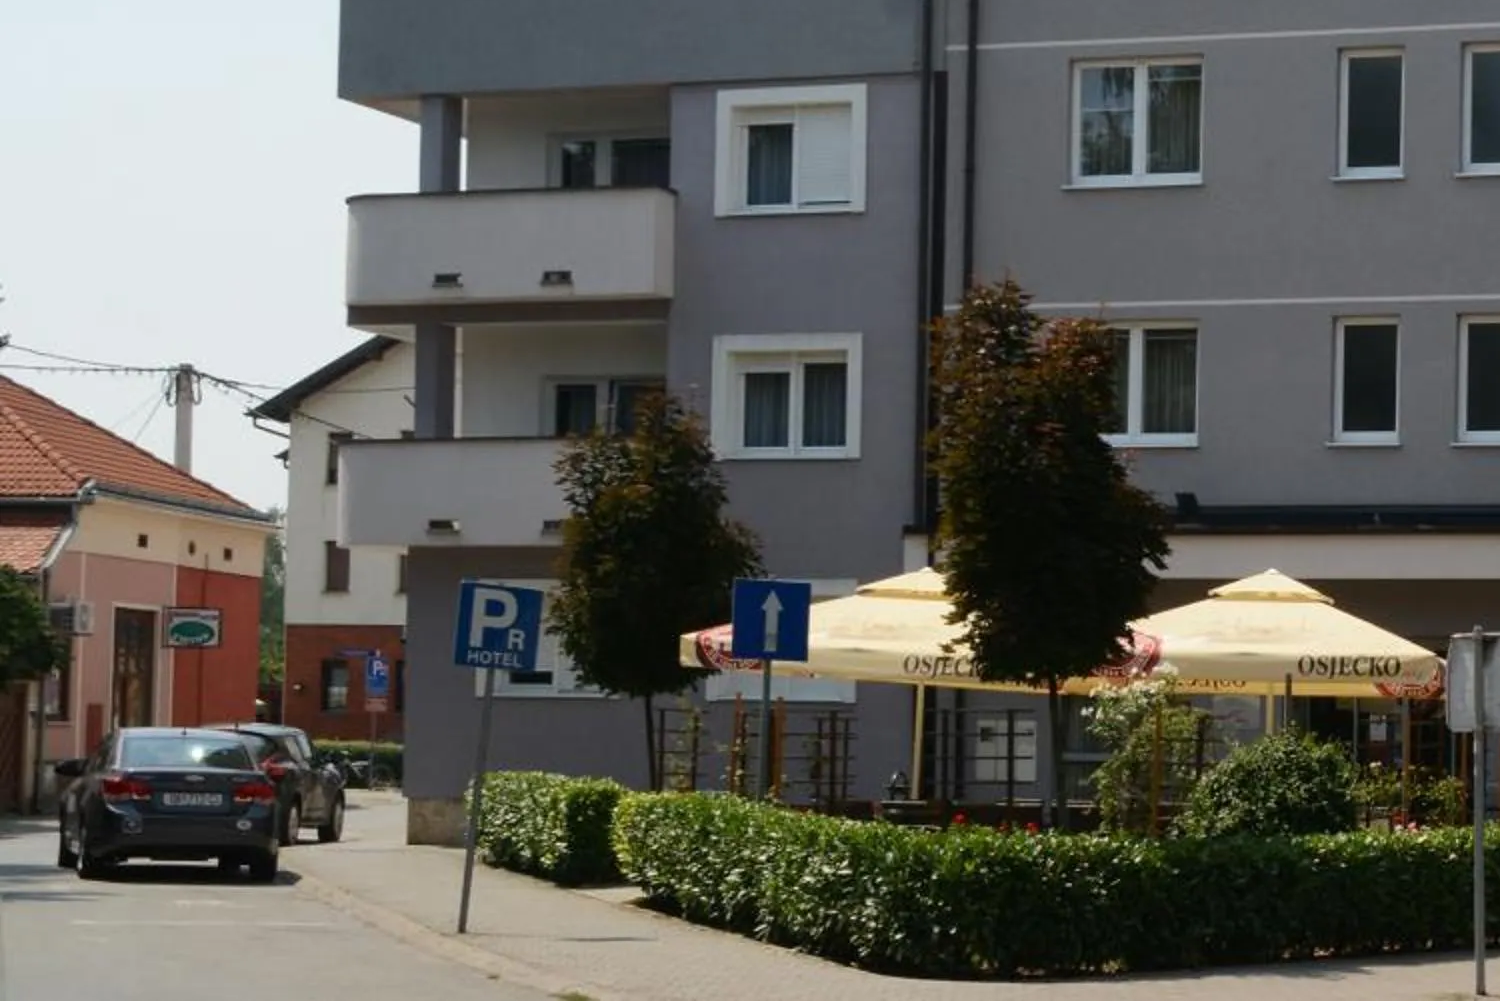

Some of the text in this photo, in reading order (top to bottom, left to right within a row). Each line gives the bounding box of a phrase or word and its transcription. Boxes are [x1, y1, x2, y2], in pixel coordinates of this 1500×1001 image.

[470, 586, 518, 648] P
[467, 649, 523, 668] HOTEL
[903, 654, 986, 679] OSJECK
[1298, 655, 1401, 679] OSJECKO
